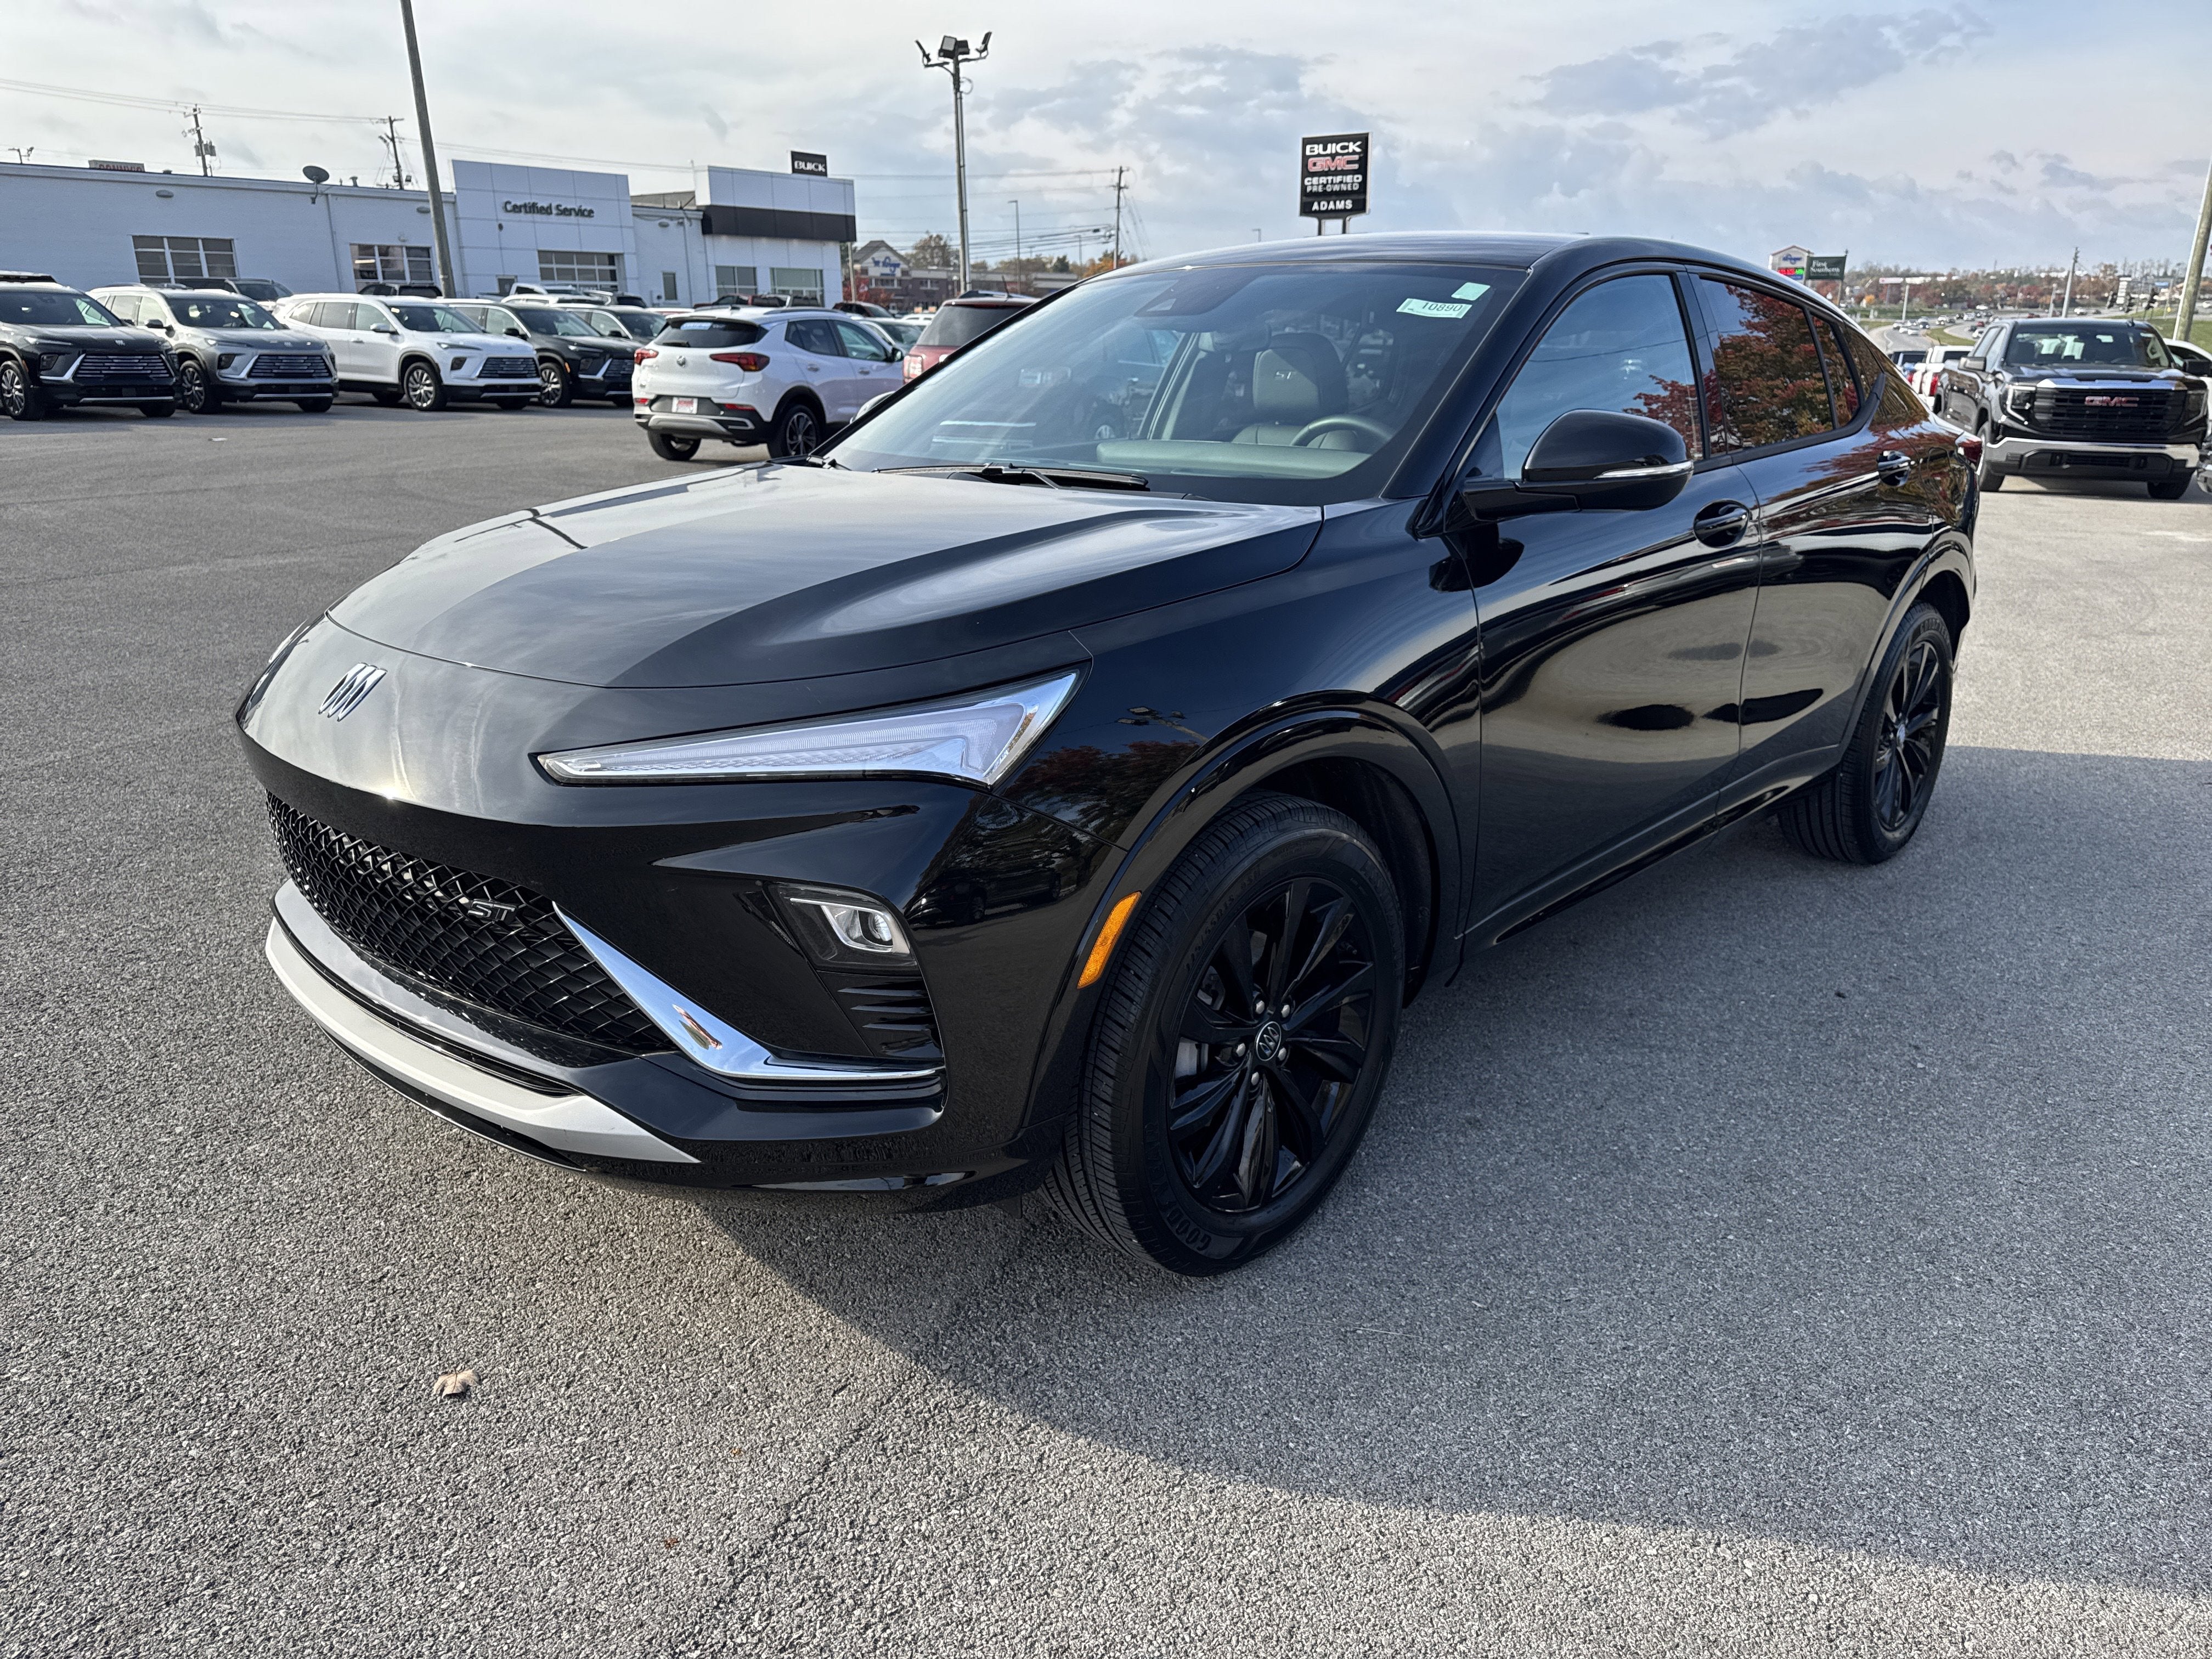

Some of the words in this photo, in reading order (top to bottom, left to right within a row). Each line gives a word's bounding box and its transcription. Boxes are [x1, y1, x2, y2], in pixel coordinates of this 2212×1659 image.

[1305, 141, 1363, 156] BUICK
[794, 160, 826, 172] BUICK
[1307, 154, 1360, 173] GMC
[1304, 174, 1363, 186] CERTIFIED
[1306, 183, 1360, 193] PRE-OWNED
[504, 200, 552, 216] Certified
[555, 204, 595, 218] Service
[1312, 199, 1353, 211] ADAMS
[1422, 302, 1463, 312] 10890
[2085, 396, 2140, 407] GMC
[467, 900, 516, 922] ST
